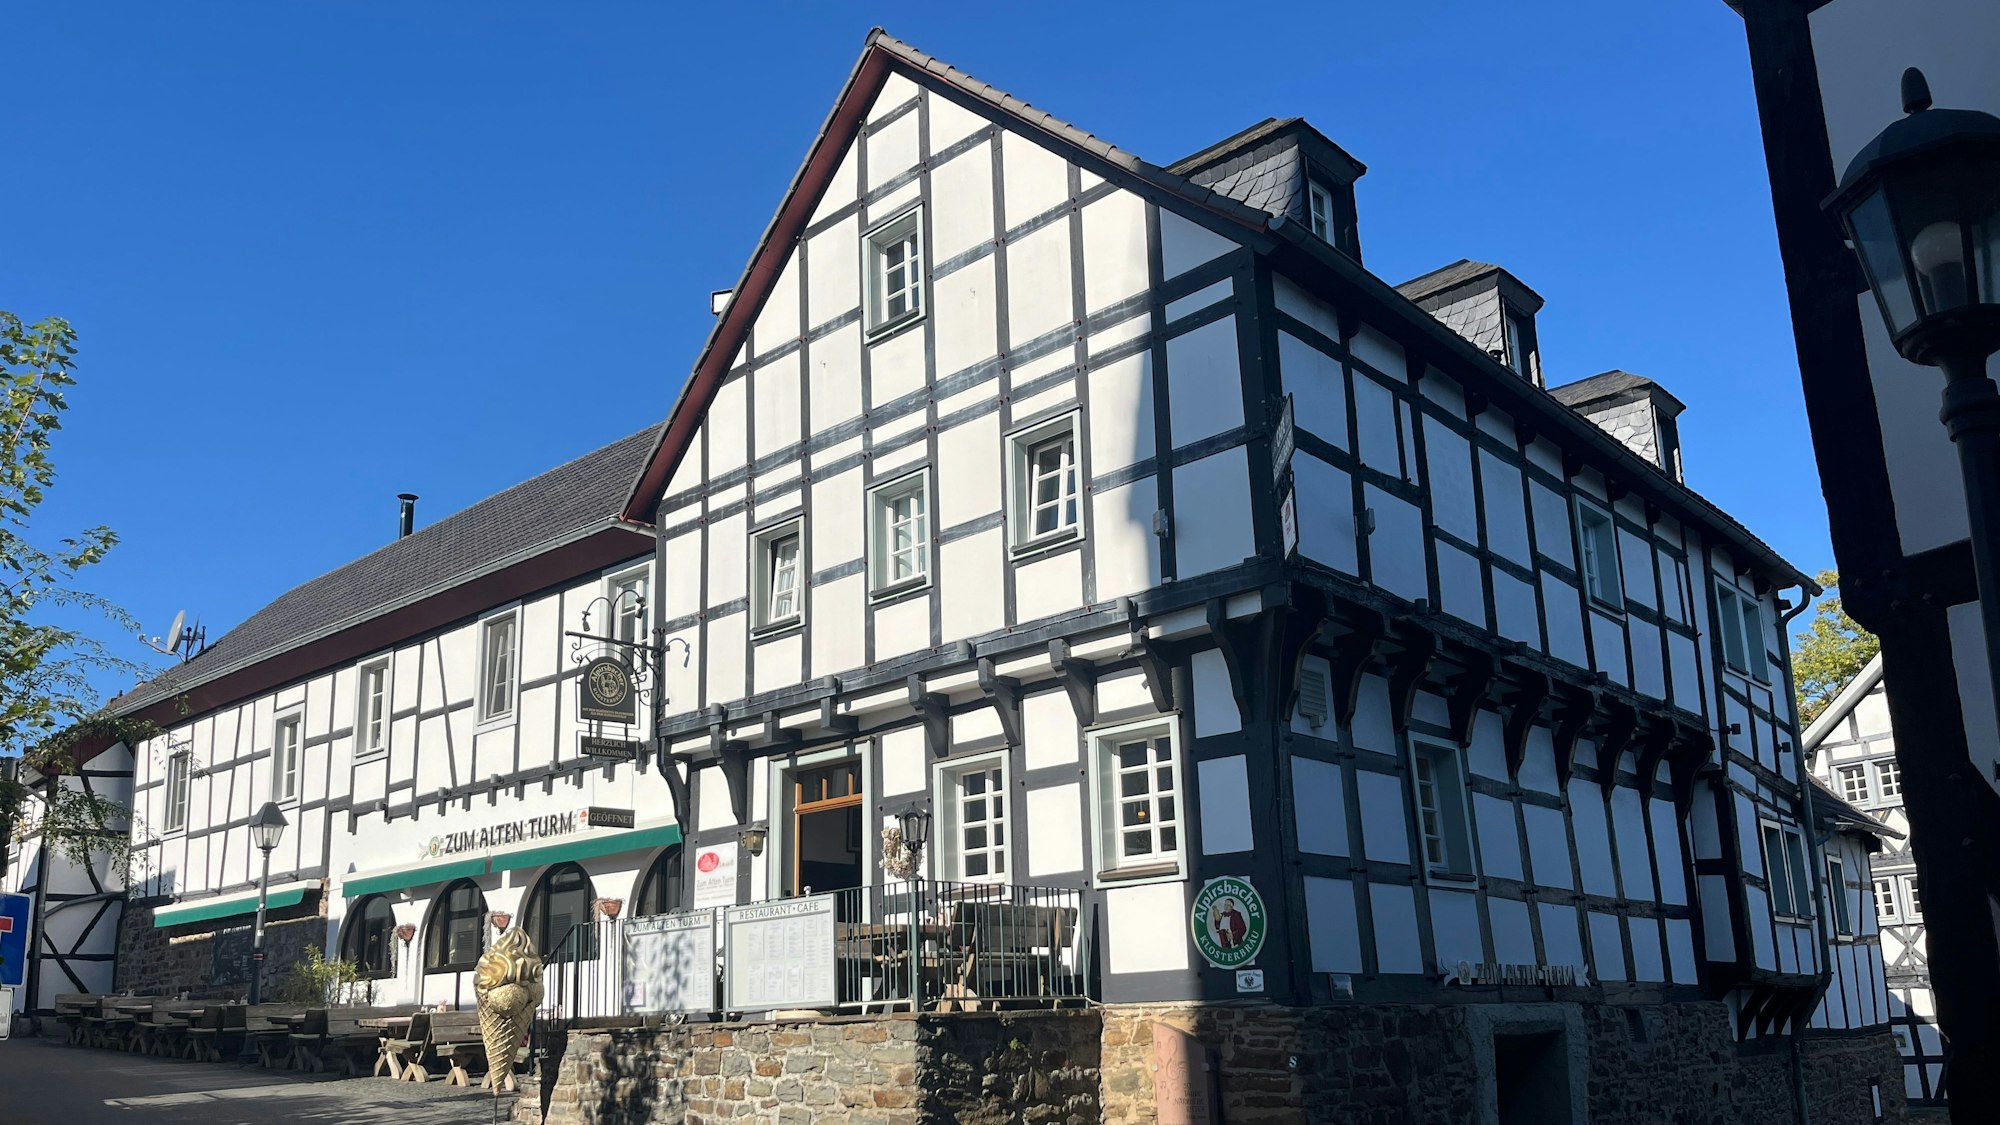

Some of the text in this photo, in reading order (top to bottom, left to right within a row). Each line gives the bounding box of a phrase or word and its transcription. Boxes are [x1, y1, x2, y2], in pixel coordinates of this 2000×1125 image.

[591, 664, 625, 687] Alpirsbacher
[591, 738, 627, 749] HERZLICH
[585, 746, 633, 758] WILLKOMMEN
[589, 811, 634, 824] GEÖFFNET
[445, 811, 574, 854] ZUM ALTEN TURM
[1195, 880, 1260, 923] Alpirsbacher
[739, 905, 792, 920] RESTAURANT
[632, 916, 701, 932] ZUM ALTEN TURM
[1199, 930, 1259, 961] KLOSTERBRÄU
